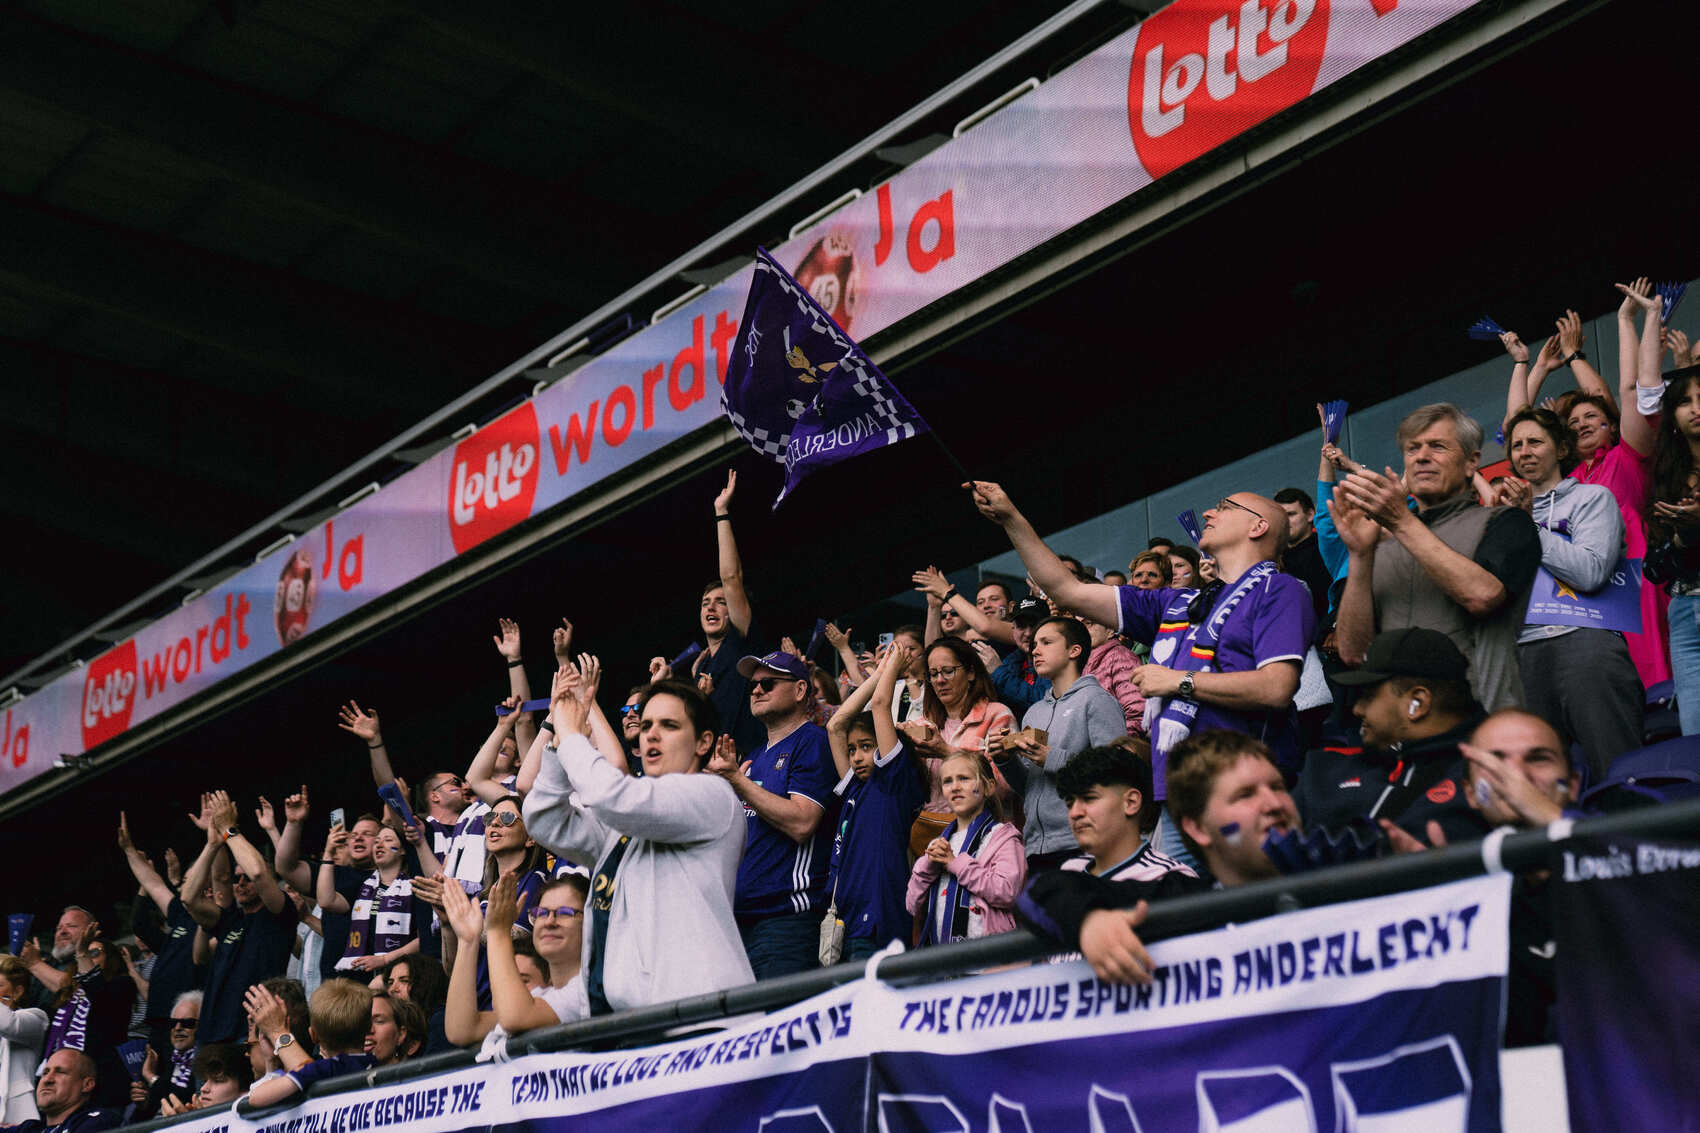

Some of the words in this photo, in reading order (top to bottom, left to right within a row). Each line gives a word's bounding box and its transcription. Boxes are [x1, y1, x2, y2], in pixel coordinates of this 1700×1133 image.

[873, 181, 956, 273] Ja
[548, 310, 738, 477] wordt
[142, 592, 252, 699] wordt
[322, 519, 364, 592] Ja
[1, 709, 30, 768] Ja
[900, 997, 952, 1034] THE
[956, 982, 1069, 1031] FAMOUS
[1074, 957, 1222, 1019] SPORTING
[1233, 903, 1480, 995] ANDERLECHT
[349, 1100, 375, 1132] DIE
[374, 1086, 449, 1127] BECAUSE
[450, 1080, 486, 1114] THE
[511, 1070, 549, 1106] TEAM
[549, 1064, 591, 1099] THAT
[590, 1061, 617, 1092] WE
[612, 1052, 671, 1087] LOVE
[663, 1042, 715, 1077] AND
[710, 1011, 822, 1065] RESPECT
[828, 1002, 853, 1040] IS
